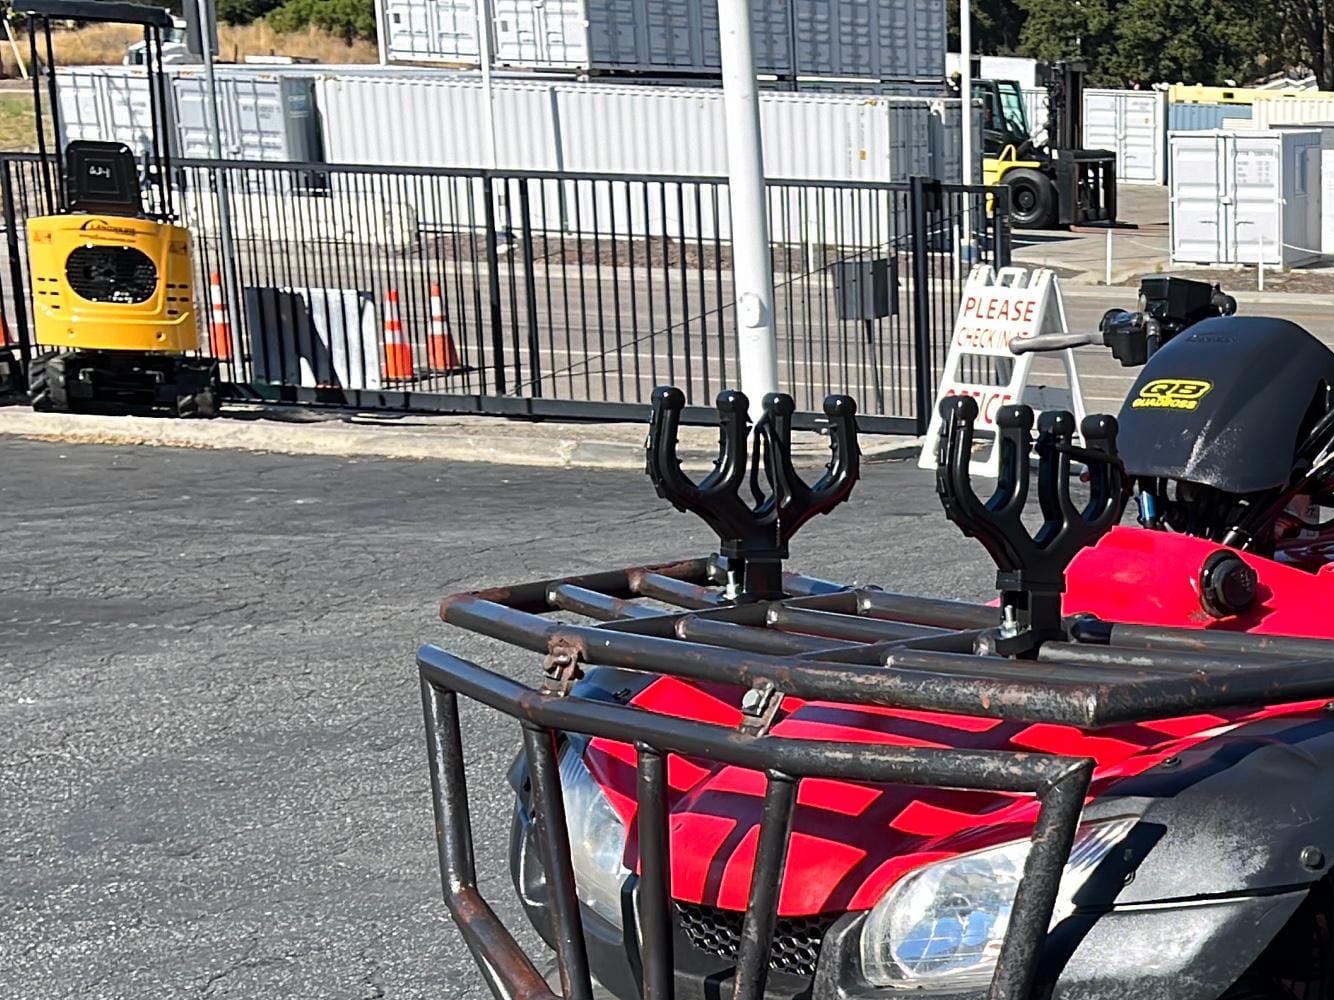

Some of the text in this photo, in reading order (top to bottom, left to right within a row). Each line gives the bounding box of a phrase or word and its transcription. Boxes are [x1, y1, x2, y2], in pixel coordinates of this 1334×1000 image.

[963, 297, 1036, 322] PLEASE
[957, 327, 995, 348] CHECK
[1141, 381, 1208, 397] QB
